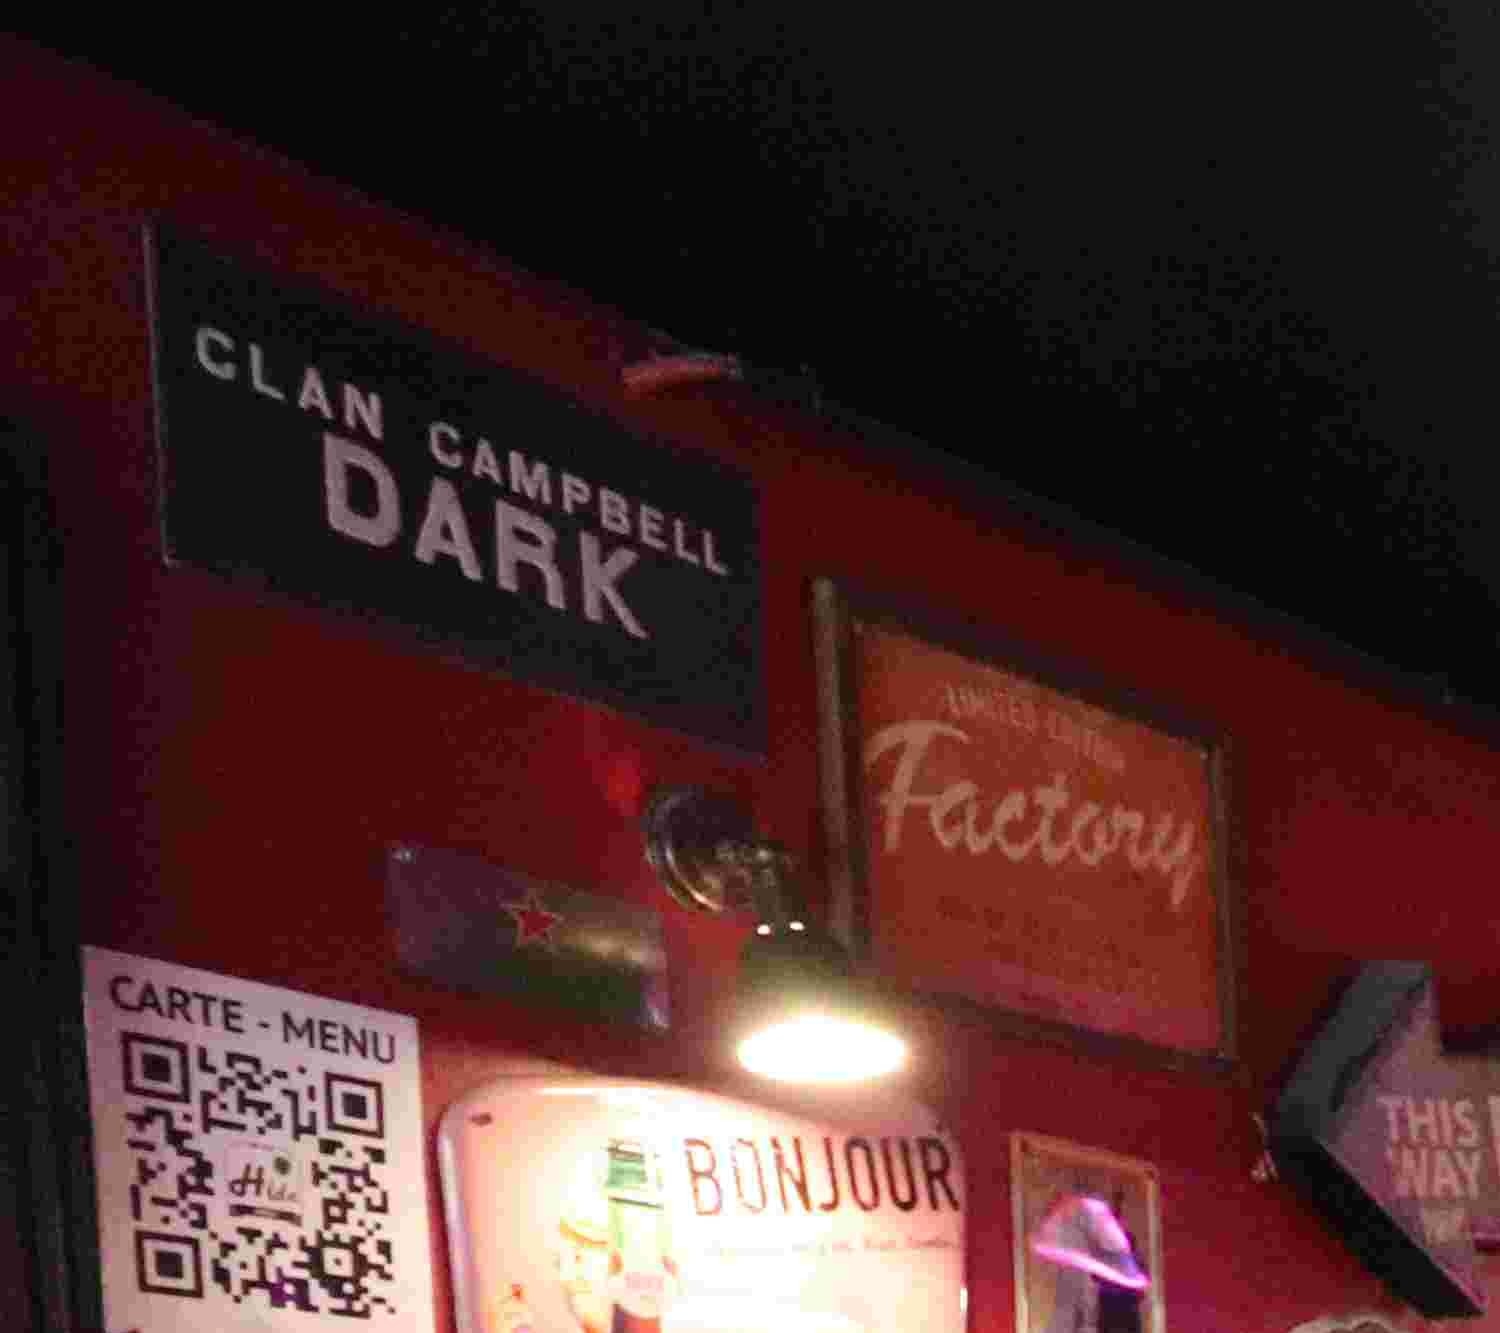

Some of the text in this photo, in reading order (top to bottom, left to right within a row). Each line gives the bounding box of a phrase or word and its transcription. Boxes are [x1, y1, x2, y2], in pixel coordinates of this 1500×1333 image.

[195, 327, 730, 578] CLAN CAMPBELL
[321, 431, 651, 641] DARK
[865, 719, 1196, 913] Factory
[108, 975, 245, 1036] CARTE
[282, 1012, 397, 1064] MENU
[1374, 1095, 1480, 1148] THIS
[682, 1135, 962, 1216] BONJOUR
[1387, 1149, 1482, 1201] WAY
